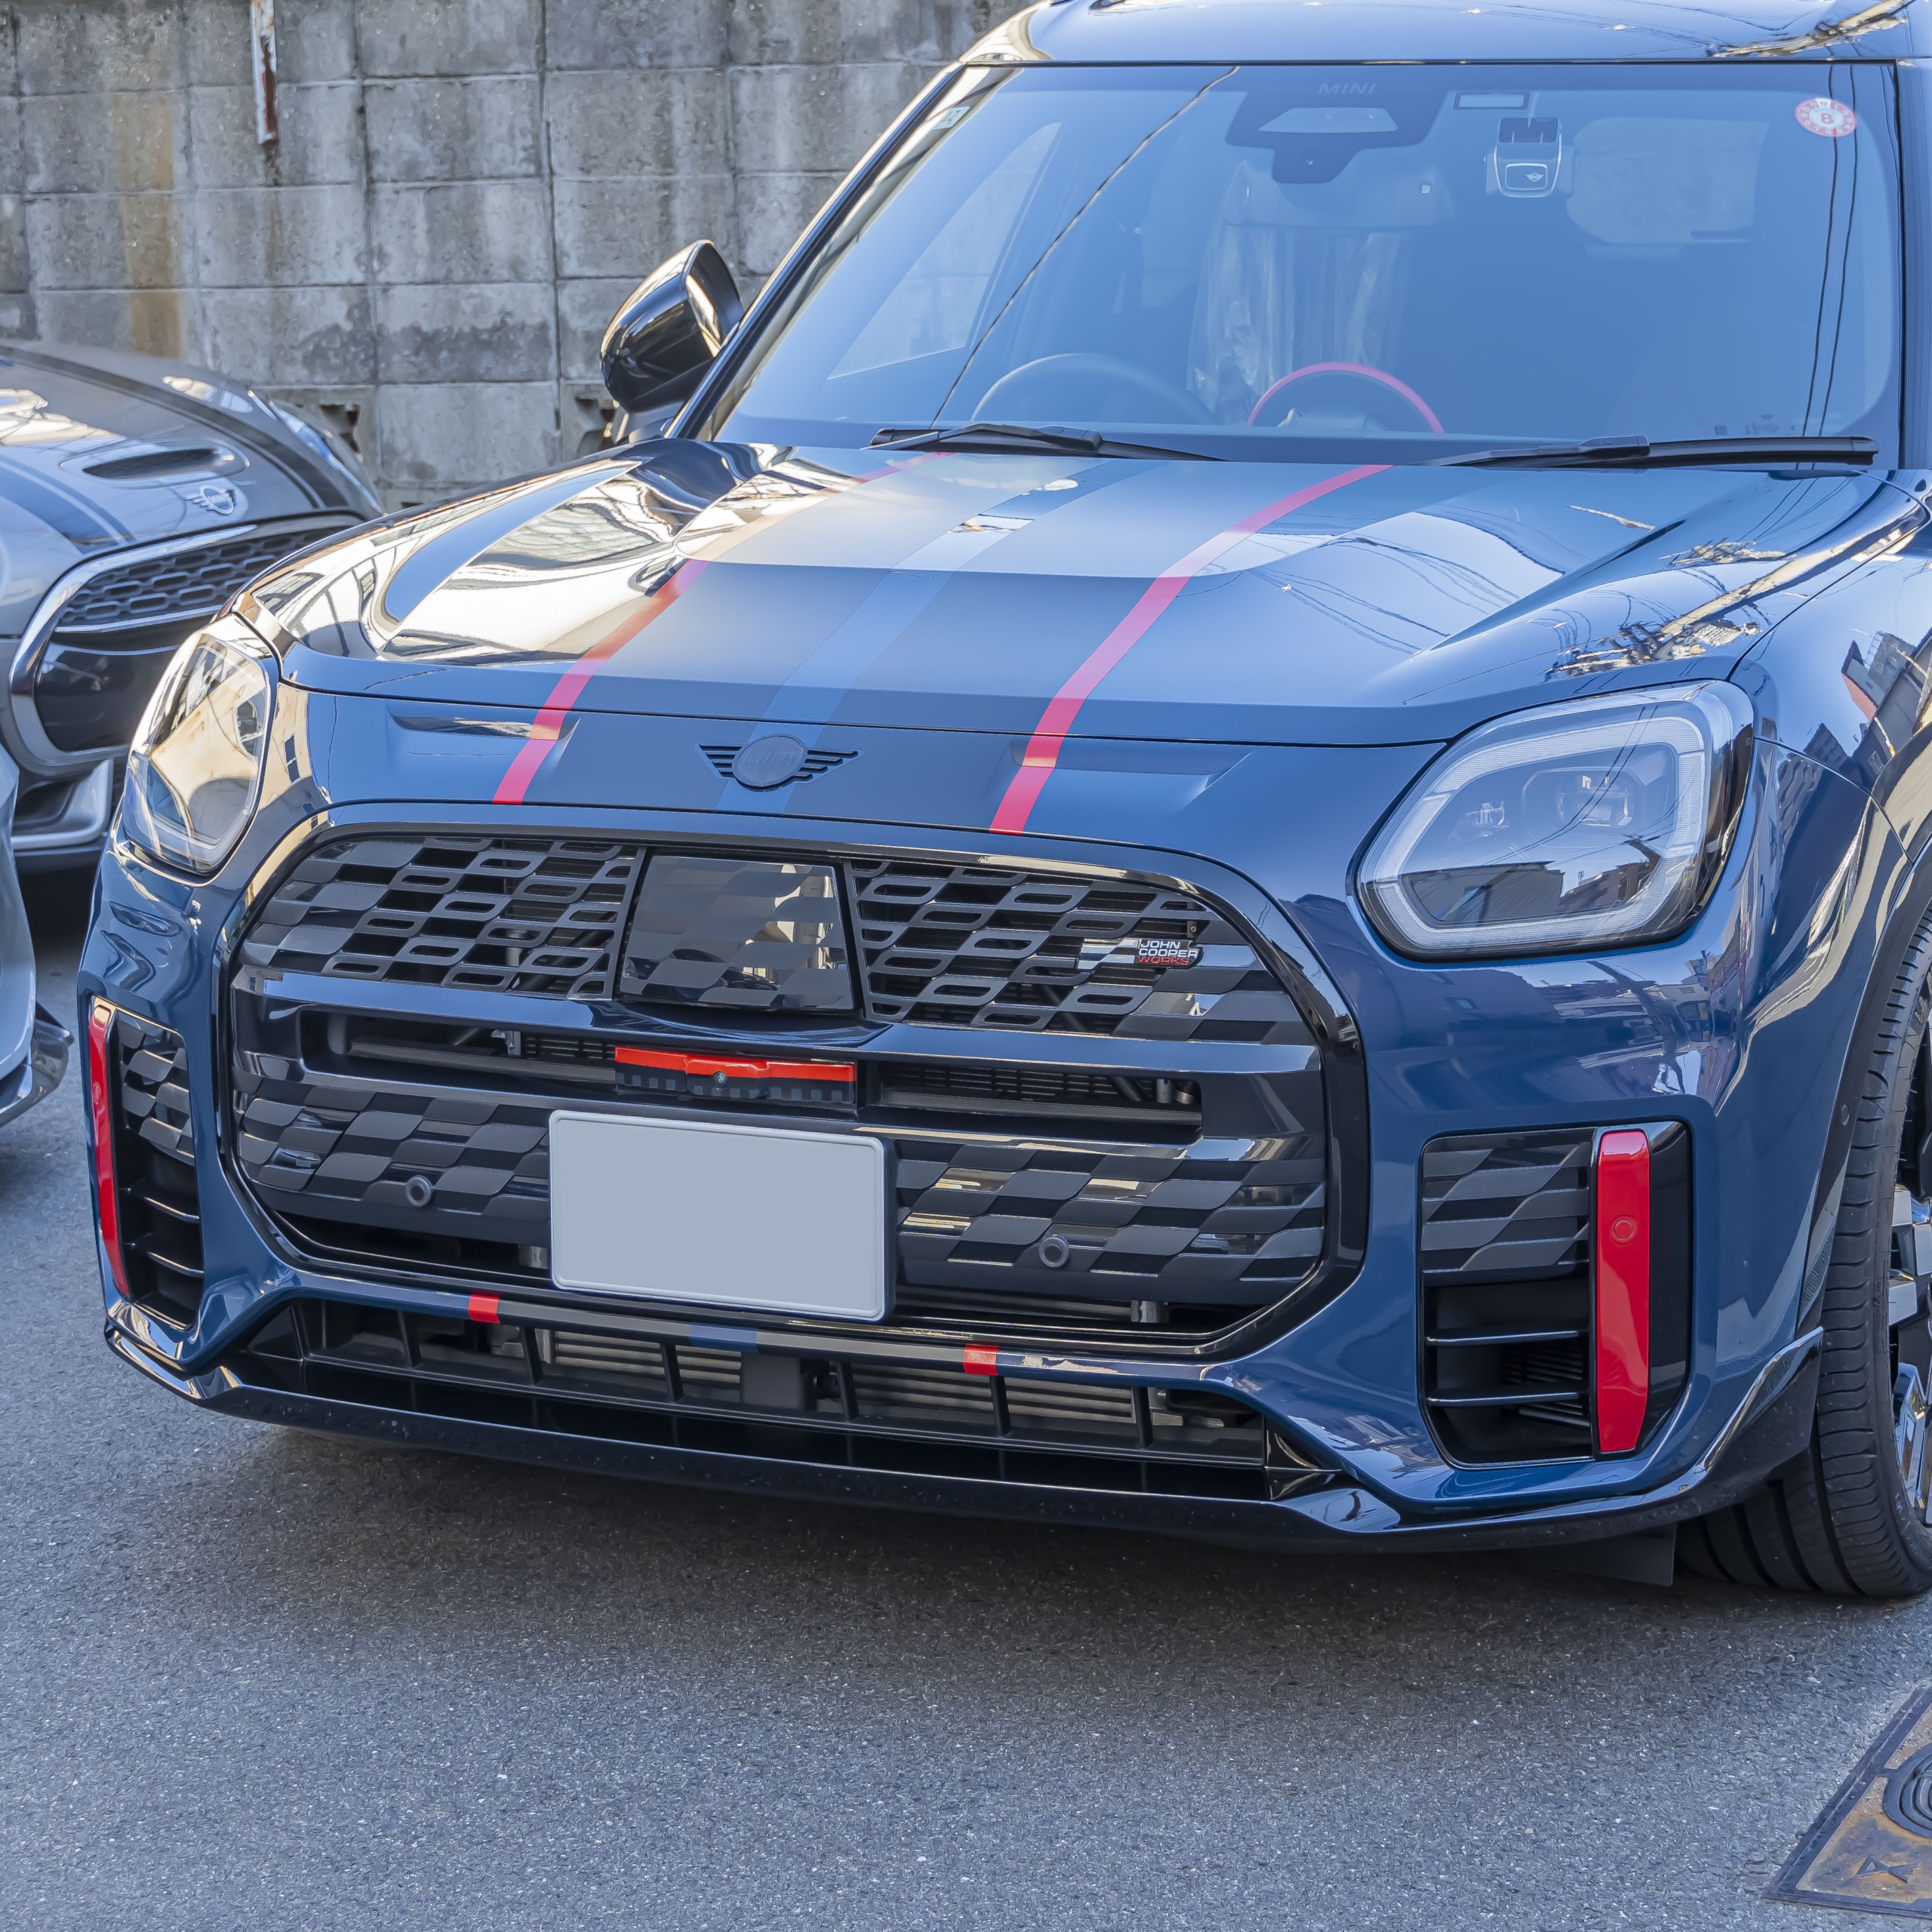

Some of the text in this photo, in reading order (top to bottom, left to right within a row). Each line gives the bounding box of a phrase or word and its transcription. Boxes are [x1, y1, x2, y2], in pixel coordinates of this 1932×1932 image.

[1318, 83, 1377, 94] MINI
[1820, 112, 1834, 125] 8
[743, 751, 798, 768] MINI
[1140, 940, 1181, 949] JOHN
[1138, 948, 1198, 959] COOPER
[1137, 956, 1190, 965] WORKS
